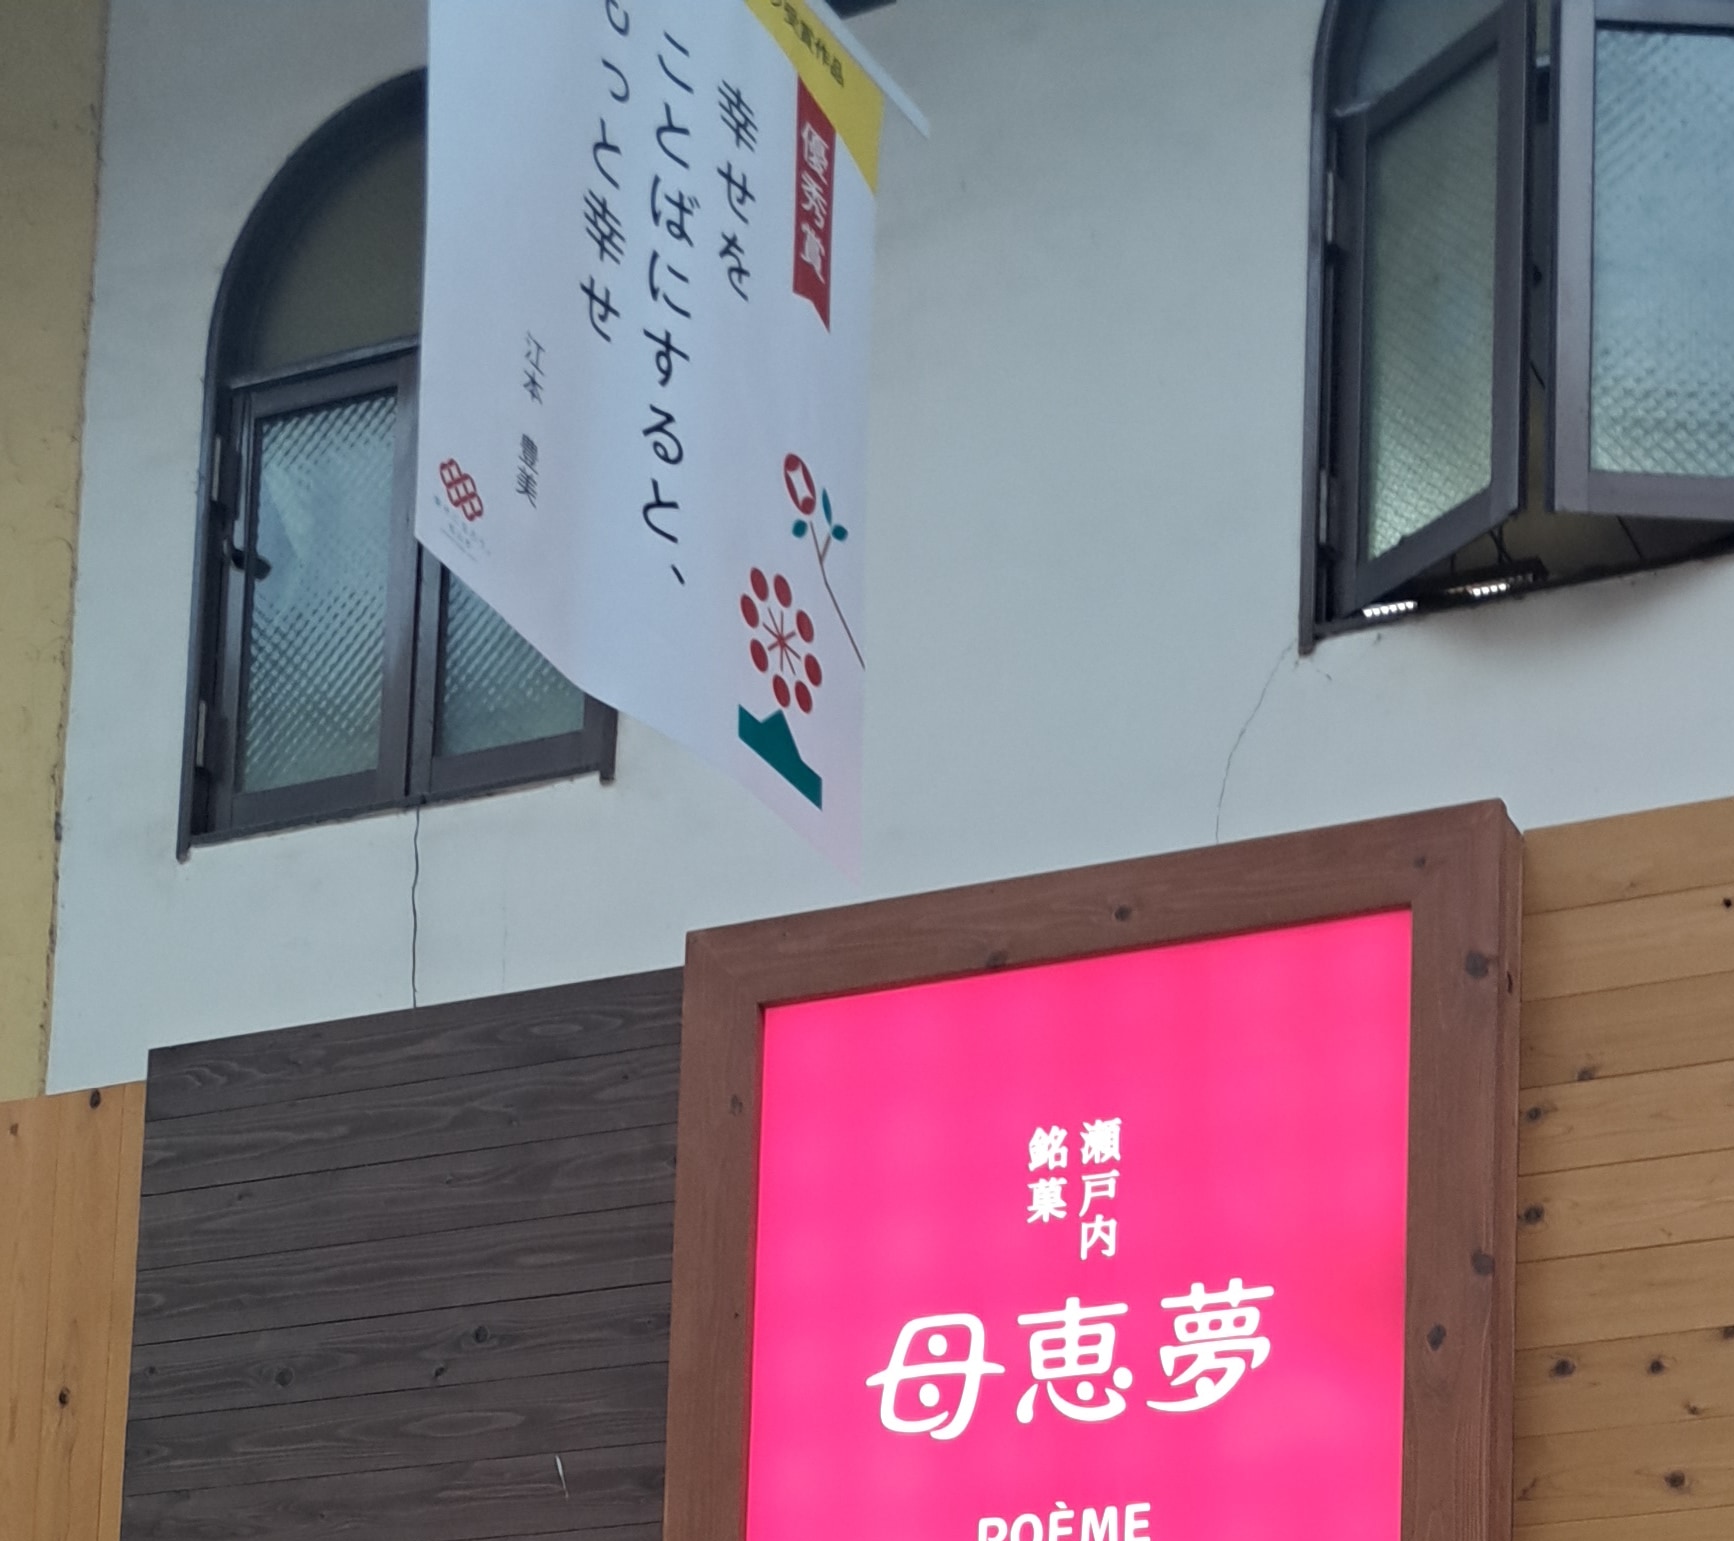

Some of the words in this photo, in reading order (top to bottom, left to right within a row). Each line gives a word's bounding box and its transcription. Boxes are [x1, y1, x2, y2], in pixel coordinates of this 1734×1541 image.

[771, 0, 845, 88] 受賞作品
[716, 79, 758, 303] 幸せを
[801, 121, 829, 285] 優秀賞
[642, 30, 701, 586] ことばにすると、
[1026, 1125, 1068, 1223] 銘菓
[1079, 1116, 1122, 1260] 瀬戸内
[865, 1277, 1275, 1441] 母恵夢
